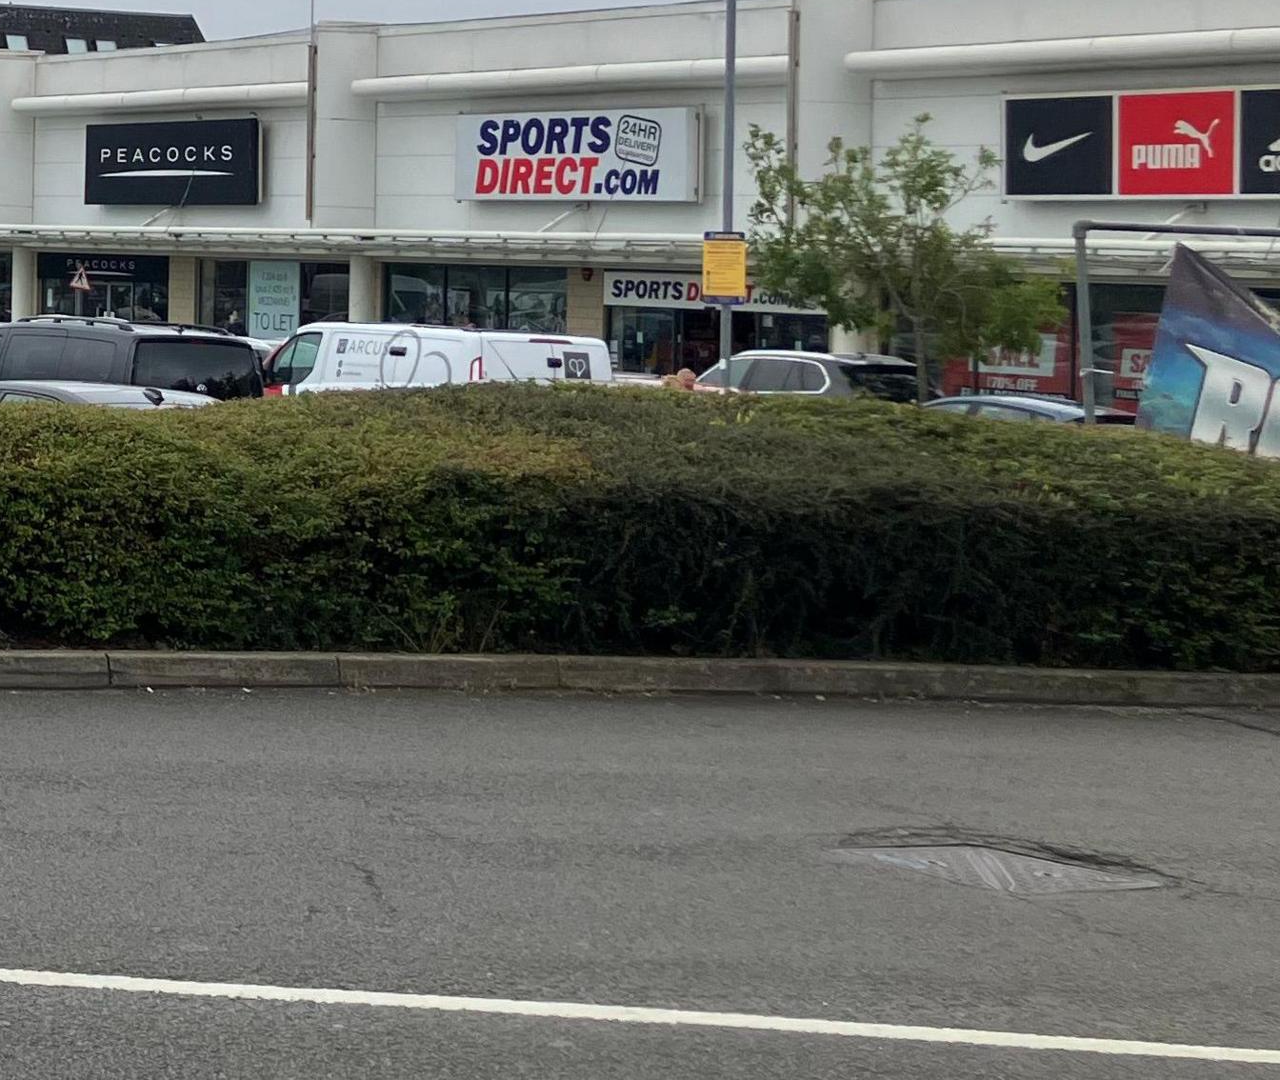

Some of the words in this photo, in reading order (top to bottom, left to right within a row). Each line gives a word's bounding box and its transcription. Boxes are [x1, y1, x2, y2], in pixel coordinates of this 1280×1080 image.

[476, 116, 612, 156] SPORTS
[621, 120, 657, 141] 24HR
[100, 145, 233, 163] PEACOCKS
[618, 136, 657, 153] DELIVERY
[1131, 143, 1200, 170] PUMA
[1258, 154, 1280, 172] a
[475, 157, 660, 195] DIRECT.COM
[66, 258, 136, 269] PEACOCKS
[611, 279, 684, 300] SPORTS
[254, 312, 270, 330] TO
[273, 314, 295, 331] LET
